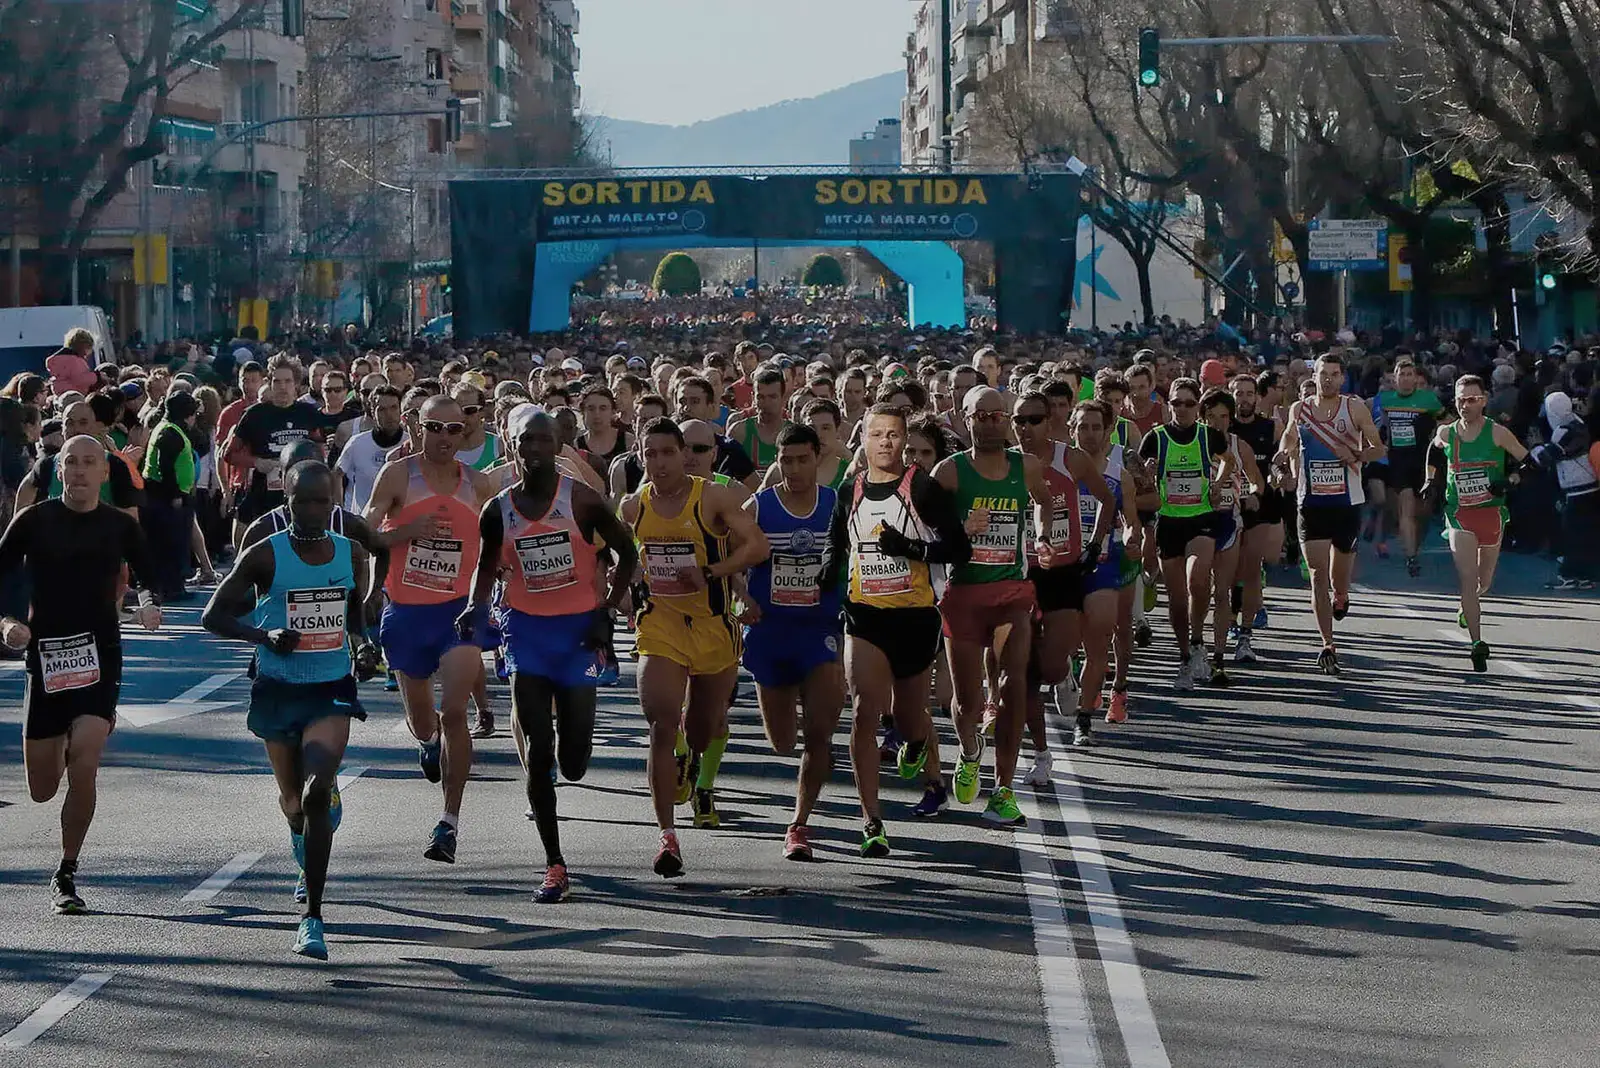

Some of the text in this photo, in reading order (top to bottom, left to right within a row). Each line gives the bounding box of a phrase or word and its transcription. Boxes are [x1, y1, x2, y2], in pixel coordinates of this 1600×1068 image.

[543, 179, 715, 206] SORTIDA
[814, 179, 987, 205] SORTIDA
[553, 215, 602, 225] MITJA
[824, 214, 874, 224] MITJA
[1312, 475, 1343, 483] SYLVAIN
[1178, 483, 1190, 493] 35
[1459, 483, 1491, 494] ALBERT
[972, 497, 1018, 511] BIKILA
[435, 541, 458, 549] adidas
[539, 535, 564, 545] adidas
[971, 534, 1016, 546] OTMANE
[541, 548, 546, 556] 1
[410, 557, 457, 573] CHEMA
[522, 554, 571, 572] KIPSANG
[861, 561, 909, 576] BEMBARKA
[315, 591, 341, 600] adidas
[315, 604, 321, 612] 3
[290, 615, 343, 629] KISANG
[63, 638, 88, 648] adidas
[57, 649, 80, 658] 5733
[45, 655, 96, 674] AMADOR
